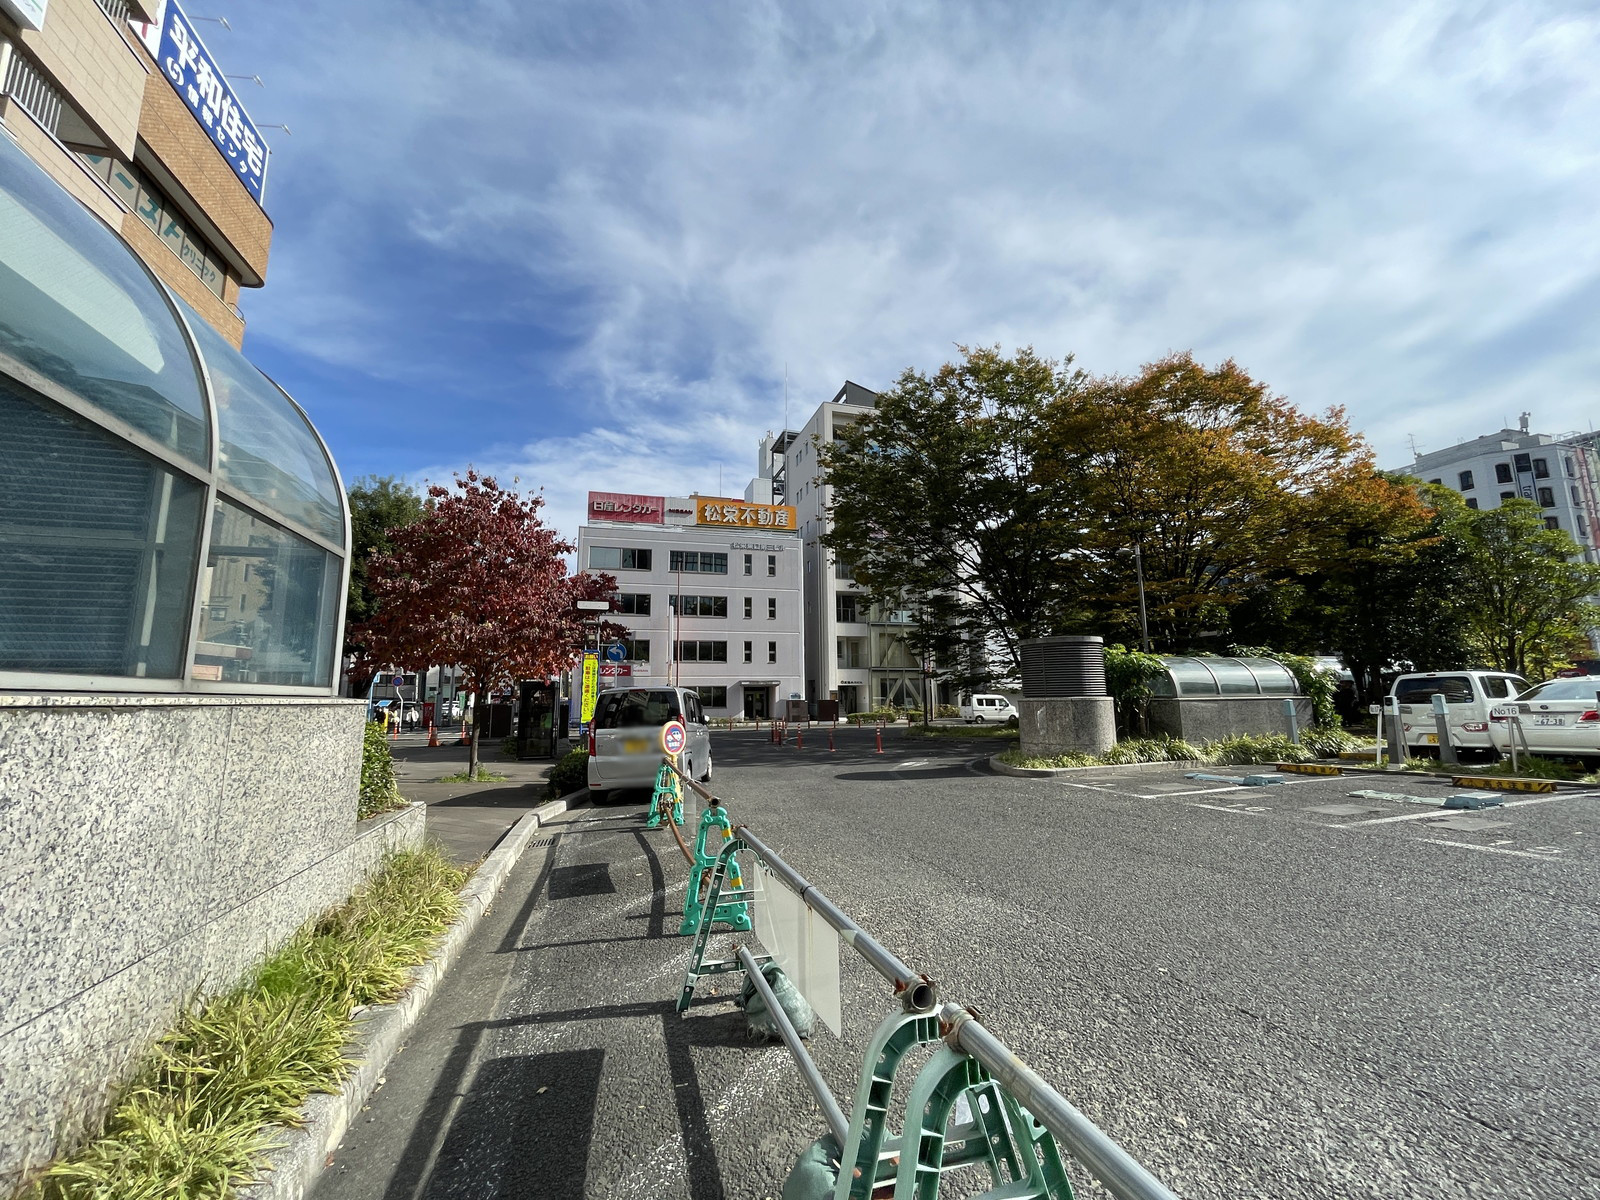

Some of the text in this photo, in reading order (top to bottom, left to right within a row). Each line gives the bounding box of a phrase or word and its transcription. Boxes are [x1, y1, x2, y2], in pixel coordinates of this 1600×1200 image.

[170, 14, 262, 177] 平和住宅
[86, 153, 181, 241] ースト
[183, 244, 216, 283] クリニック
[593, 501, 659, 514] 日産レンタカー
[704, 503, 789, 526] 松栄不動産
